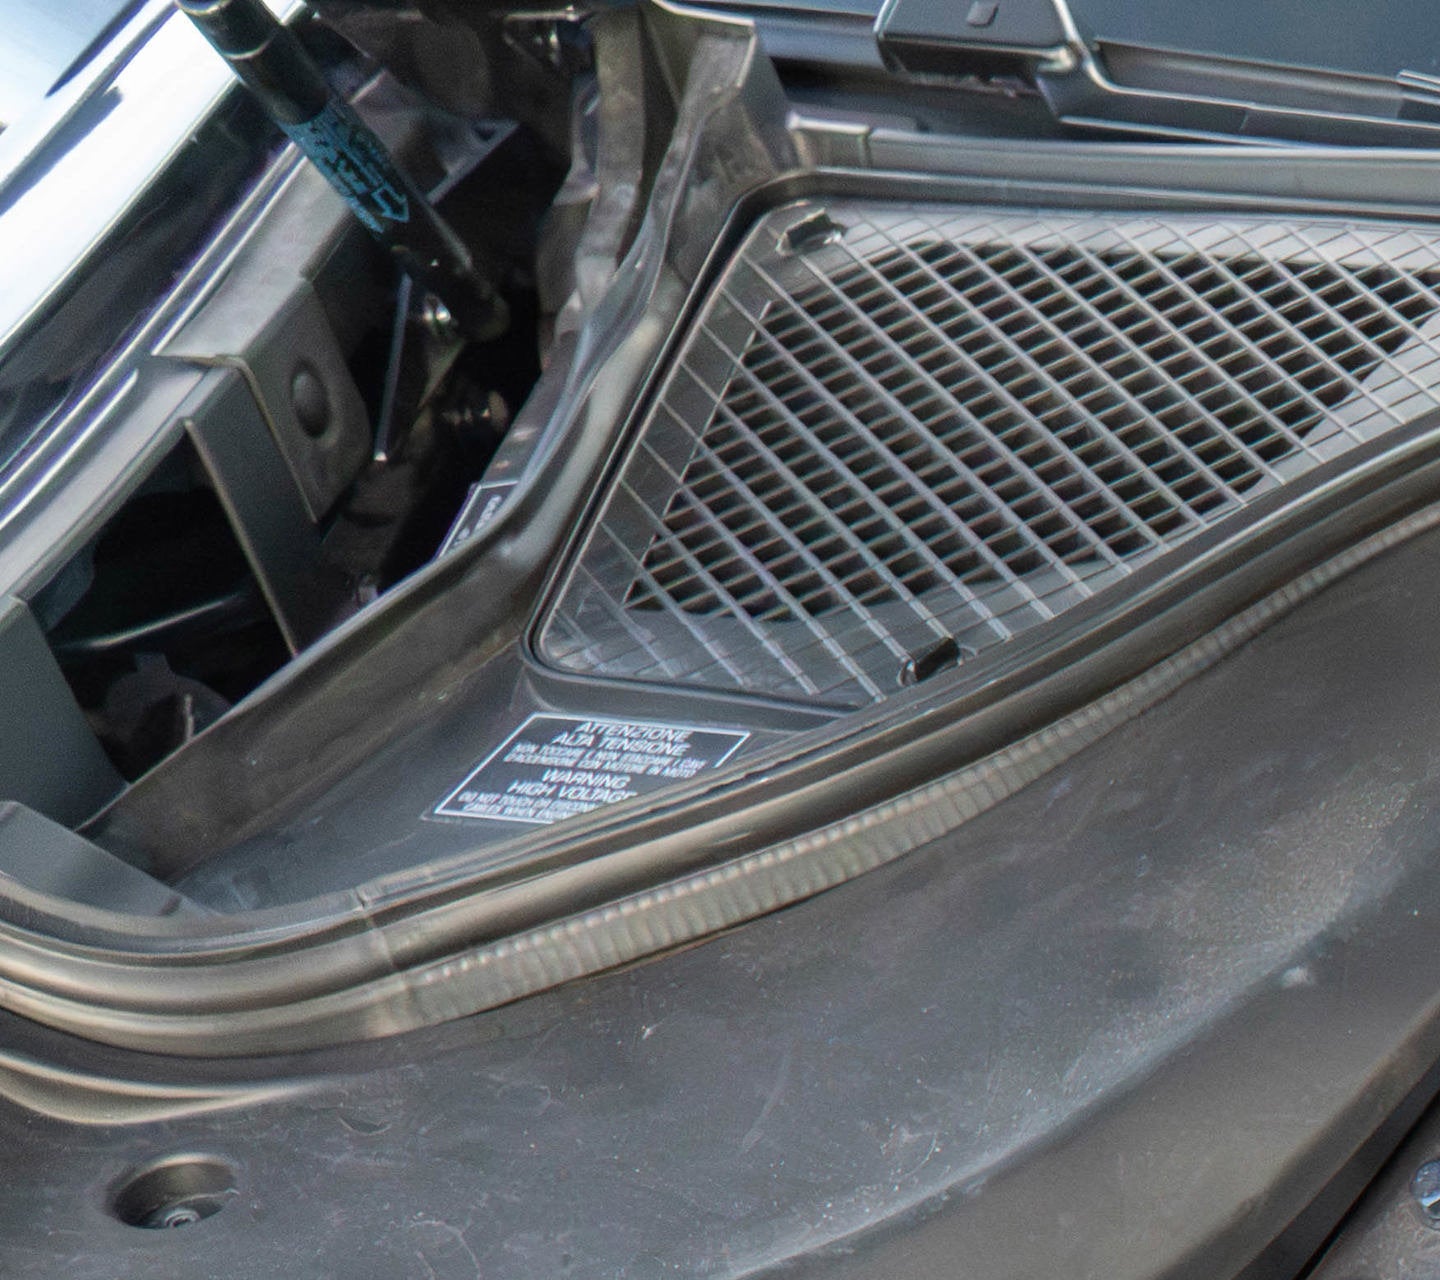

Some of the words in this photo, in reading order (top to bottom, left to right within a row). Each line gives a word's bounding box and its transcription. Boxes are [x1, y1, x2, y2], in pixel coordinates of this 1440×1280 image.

[577, 721, 692, 741] ATTENZIONE
[553, 732, 597, 746] ALTA
[598, 736, 690, 754] TENSIONE
[507, 780, 556, 795] HIGH
[539, 769, 631, 788] WARNING
